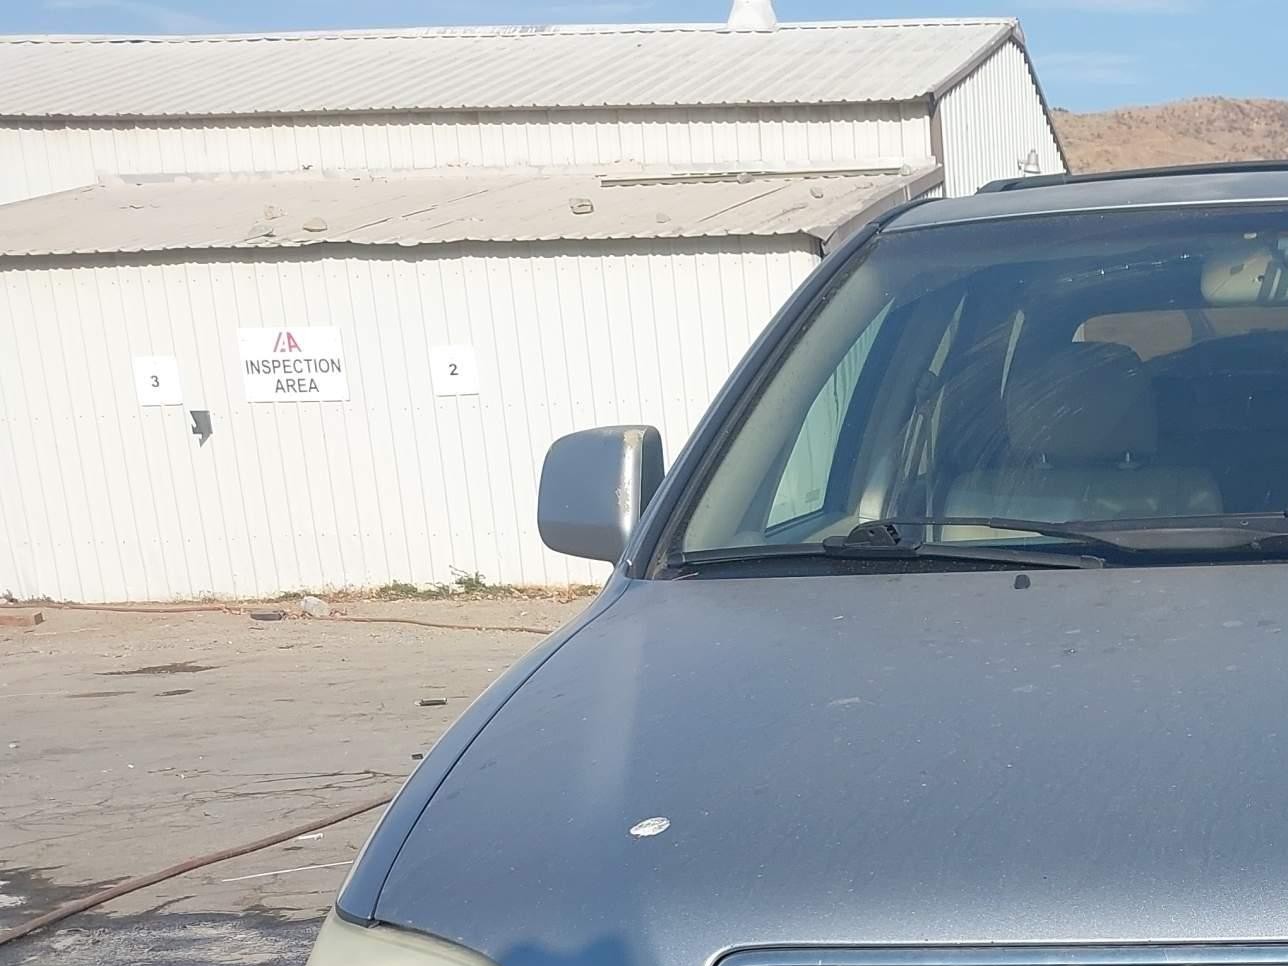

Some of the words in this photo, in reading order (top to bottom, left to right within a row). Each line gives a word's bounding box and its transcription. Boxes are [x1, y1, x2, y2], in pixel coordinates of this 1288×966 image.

[245, 358, 342, 375] INSPECTION
[448, 363, 459, 376] 2
[150, 375, 160, 388] 3
[275, 378, 320, 393] AREA
